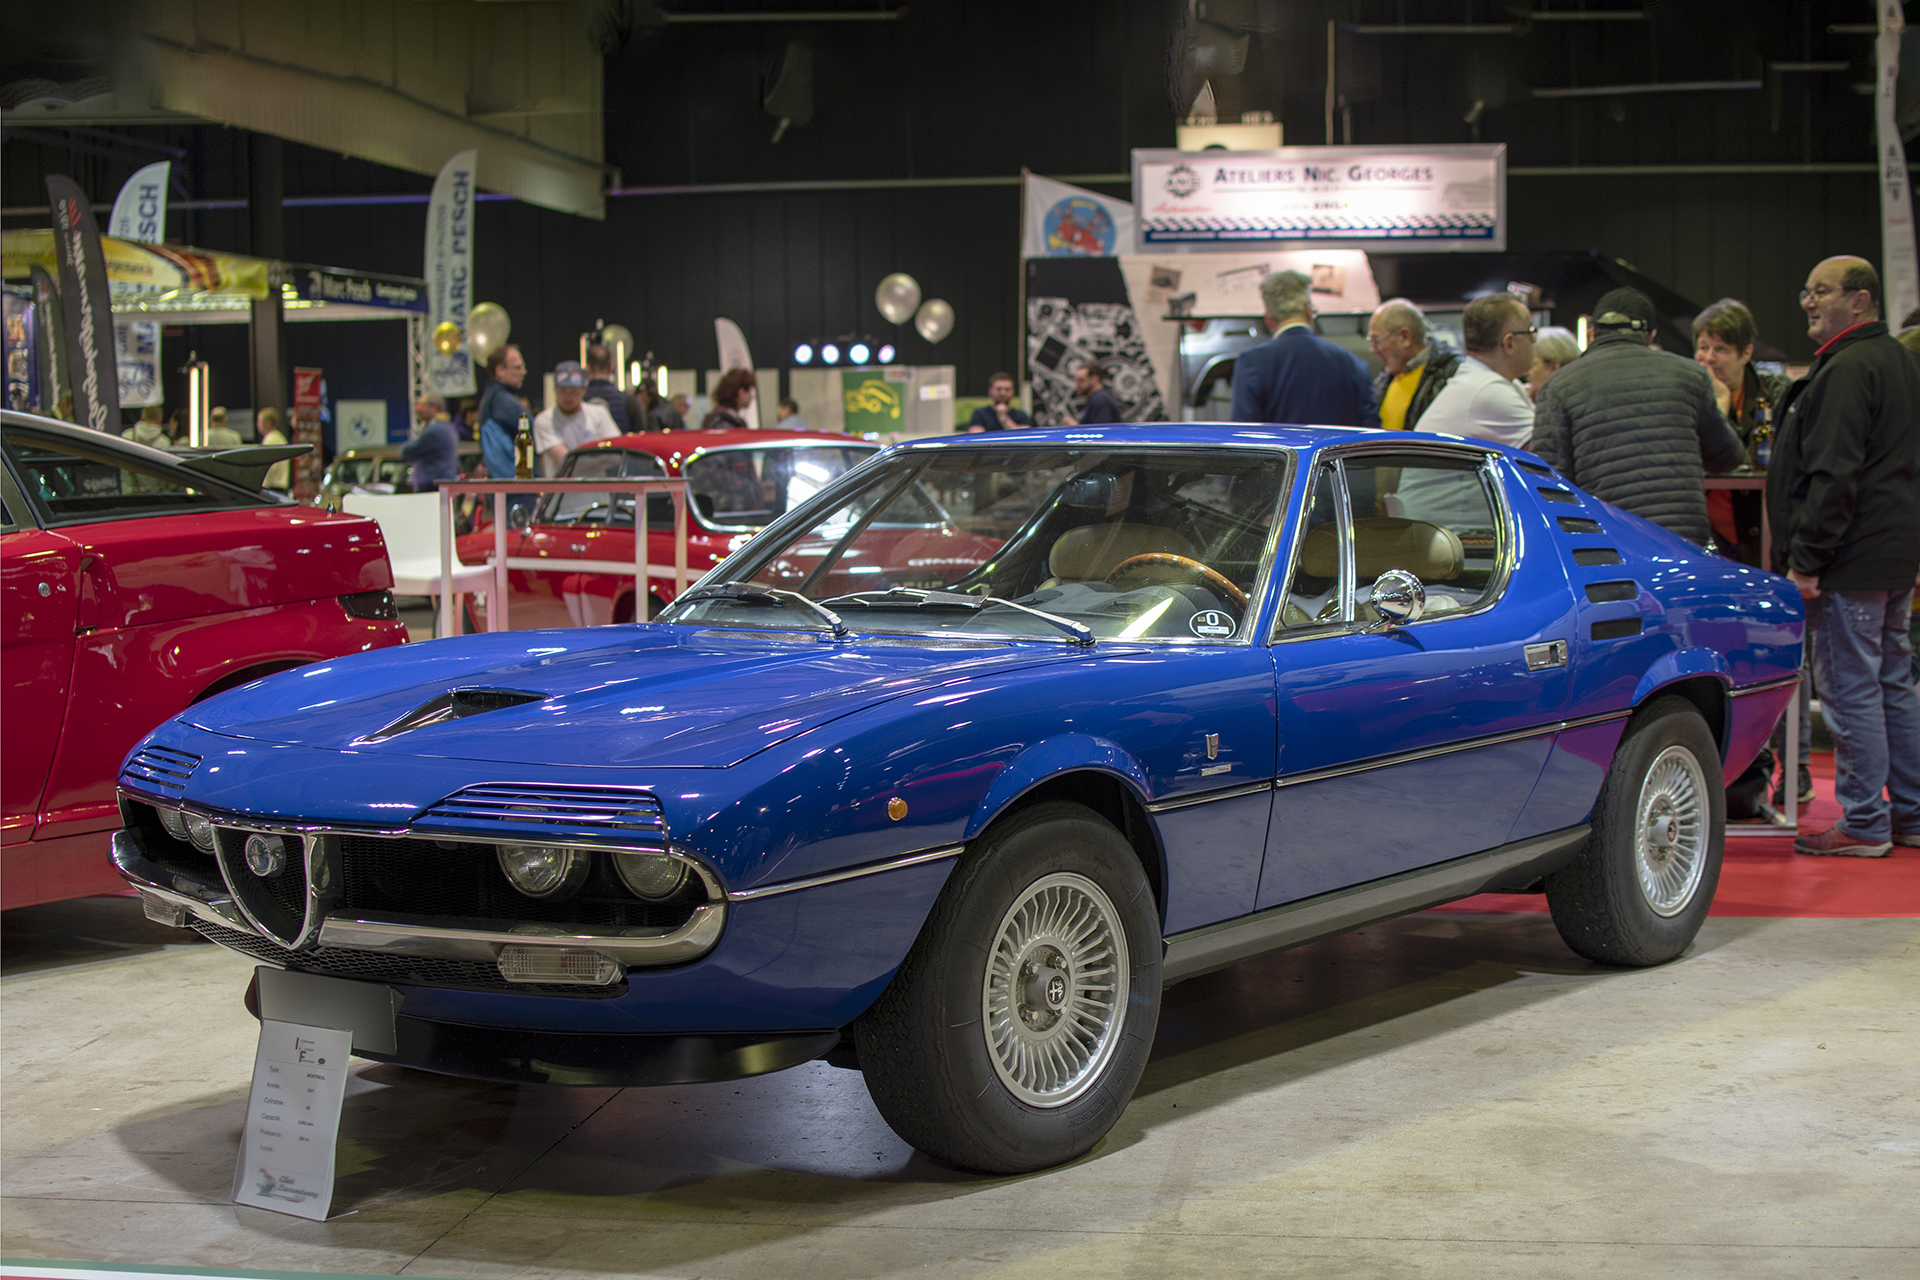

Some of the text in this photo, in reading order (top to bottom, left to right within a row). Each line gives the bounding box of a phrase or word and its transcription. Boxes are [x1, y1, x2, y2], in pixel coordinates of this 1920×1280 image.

[1215, 167, 1295, 184] ATELIERS
[1347, 165, 1434, 182] GEORGES
[451, 170, 469, 255] PESCH
